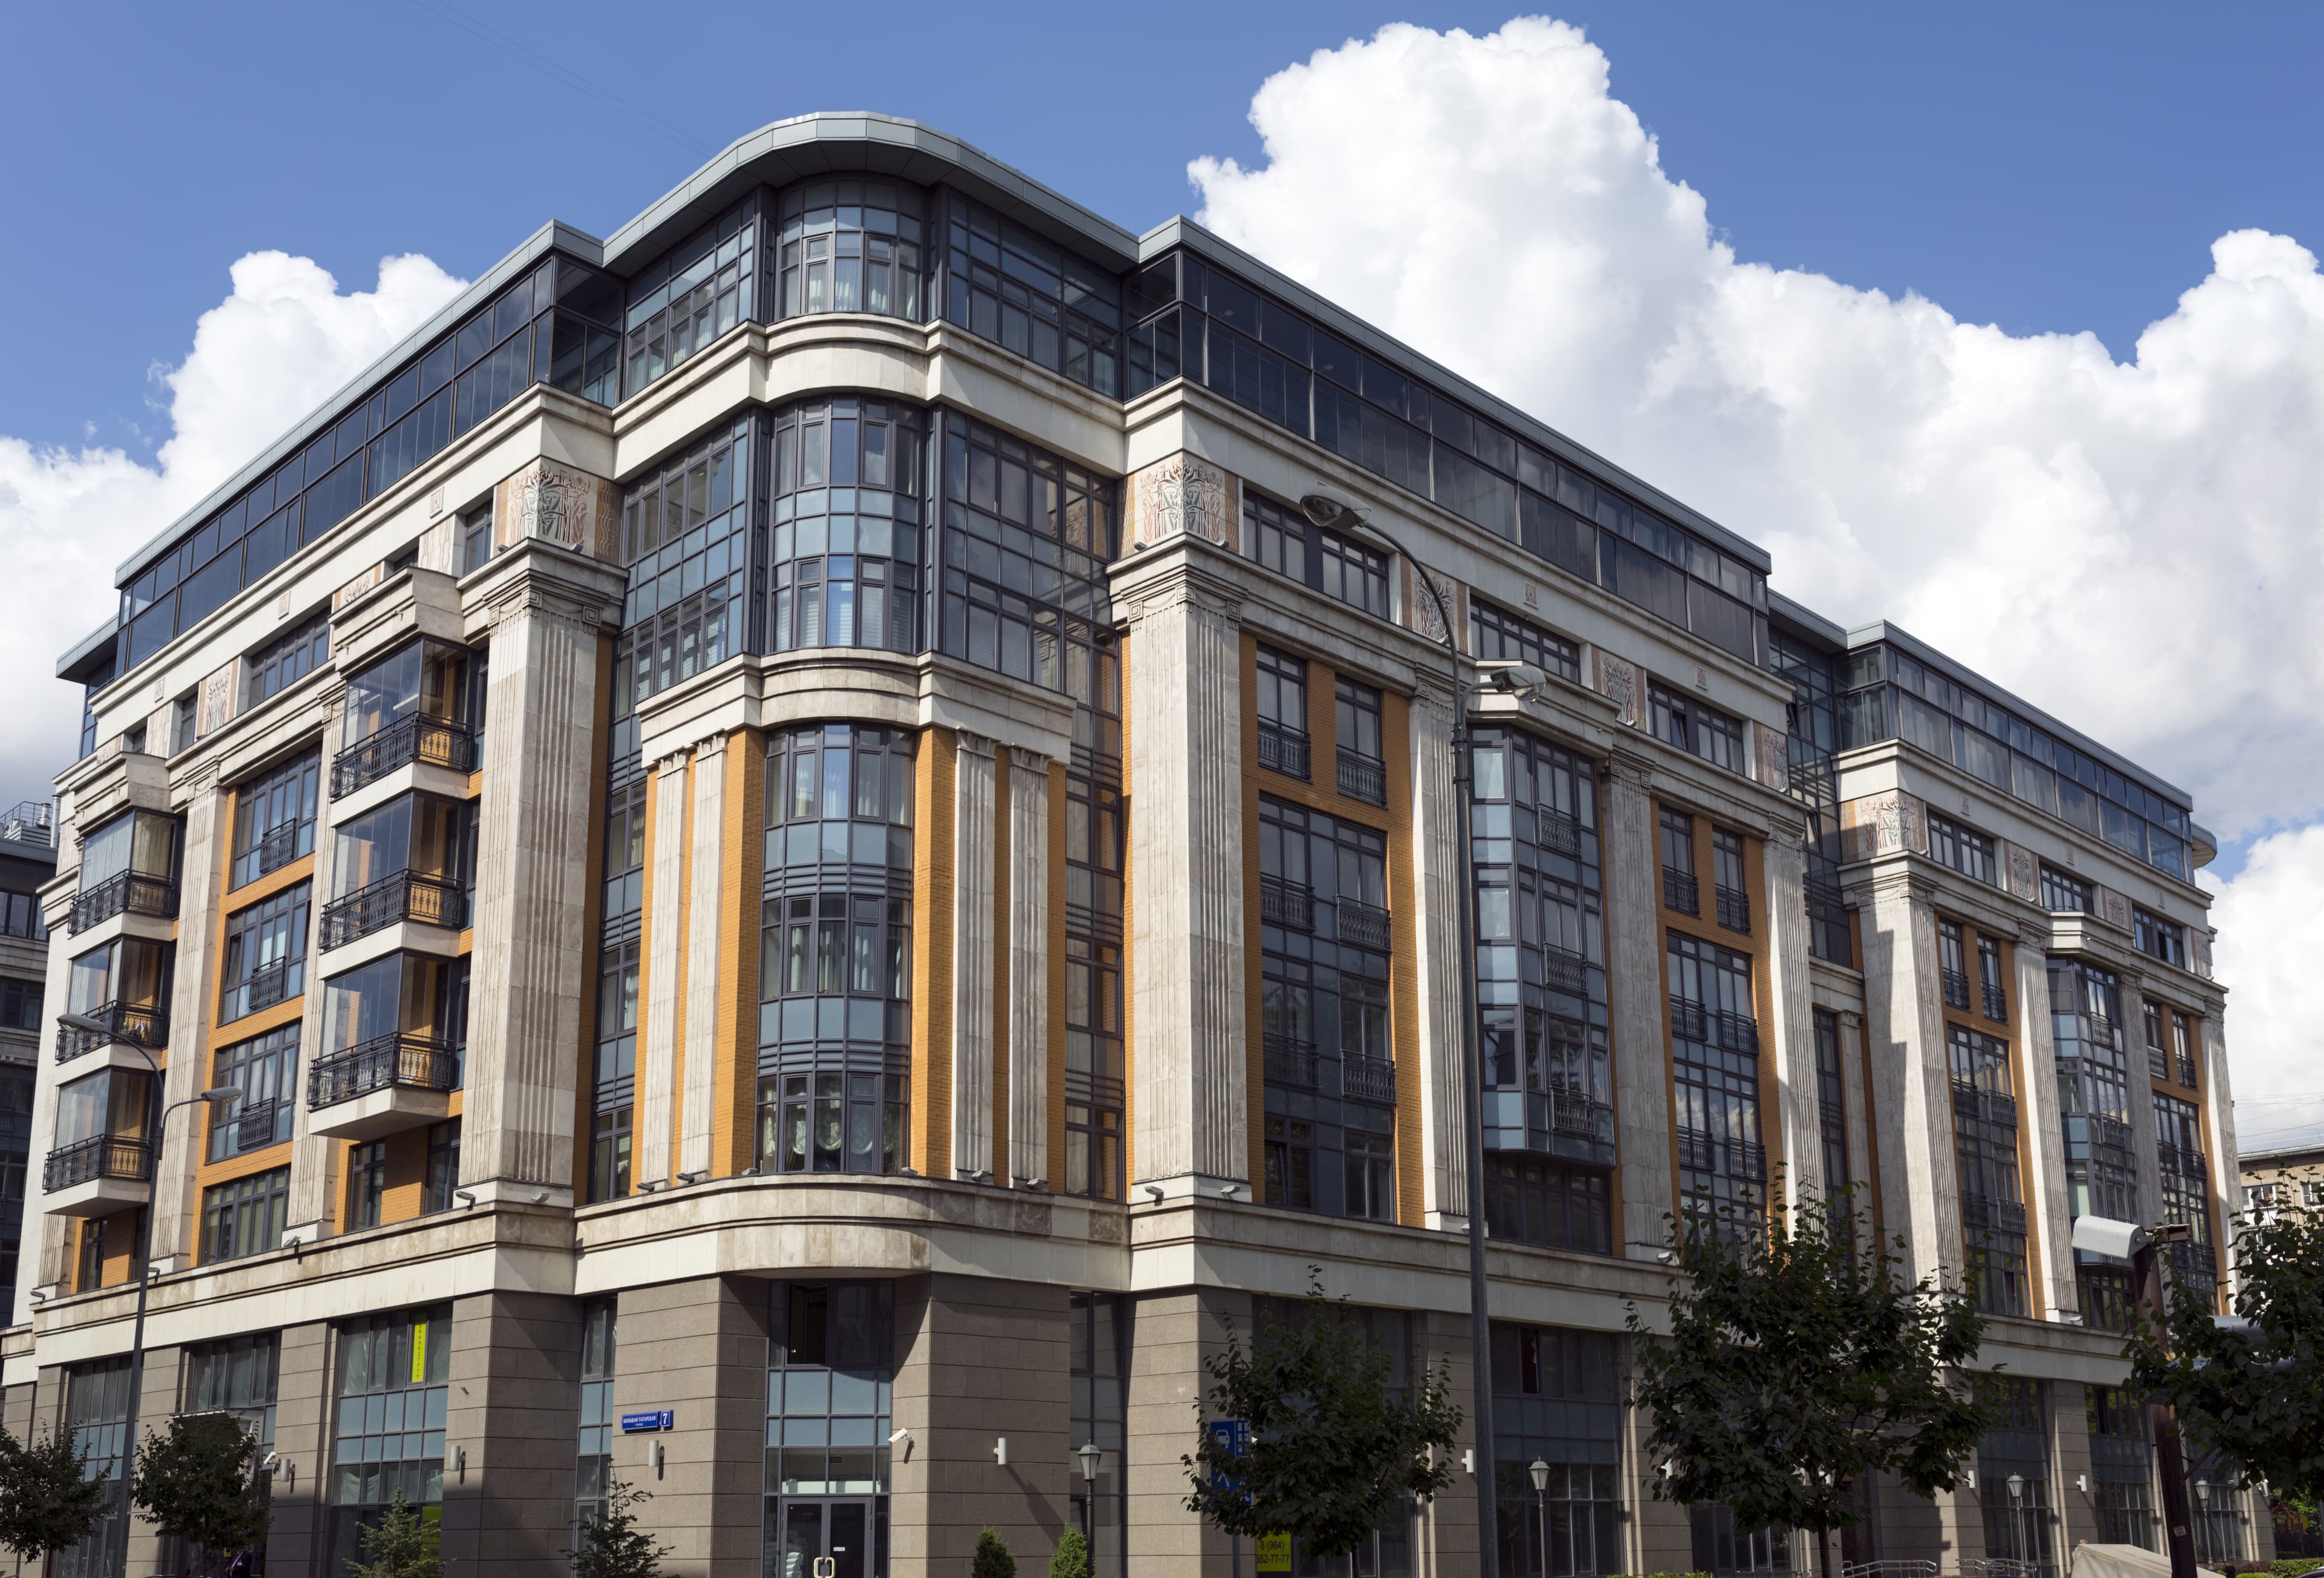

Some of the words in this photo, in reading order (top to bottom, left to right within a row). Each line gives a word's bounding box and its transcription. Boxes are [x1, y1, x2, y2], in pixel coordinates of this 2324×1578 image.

[663, 1413, 668, 1424] 7
[1260, 1540, 1264, 1550] 8
[1267, 1540, 1284, 1553] (964)
